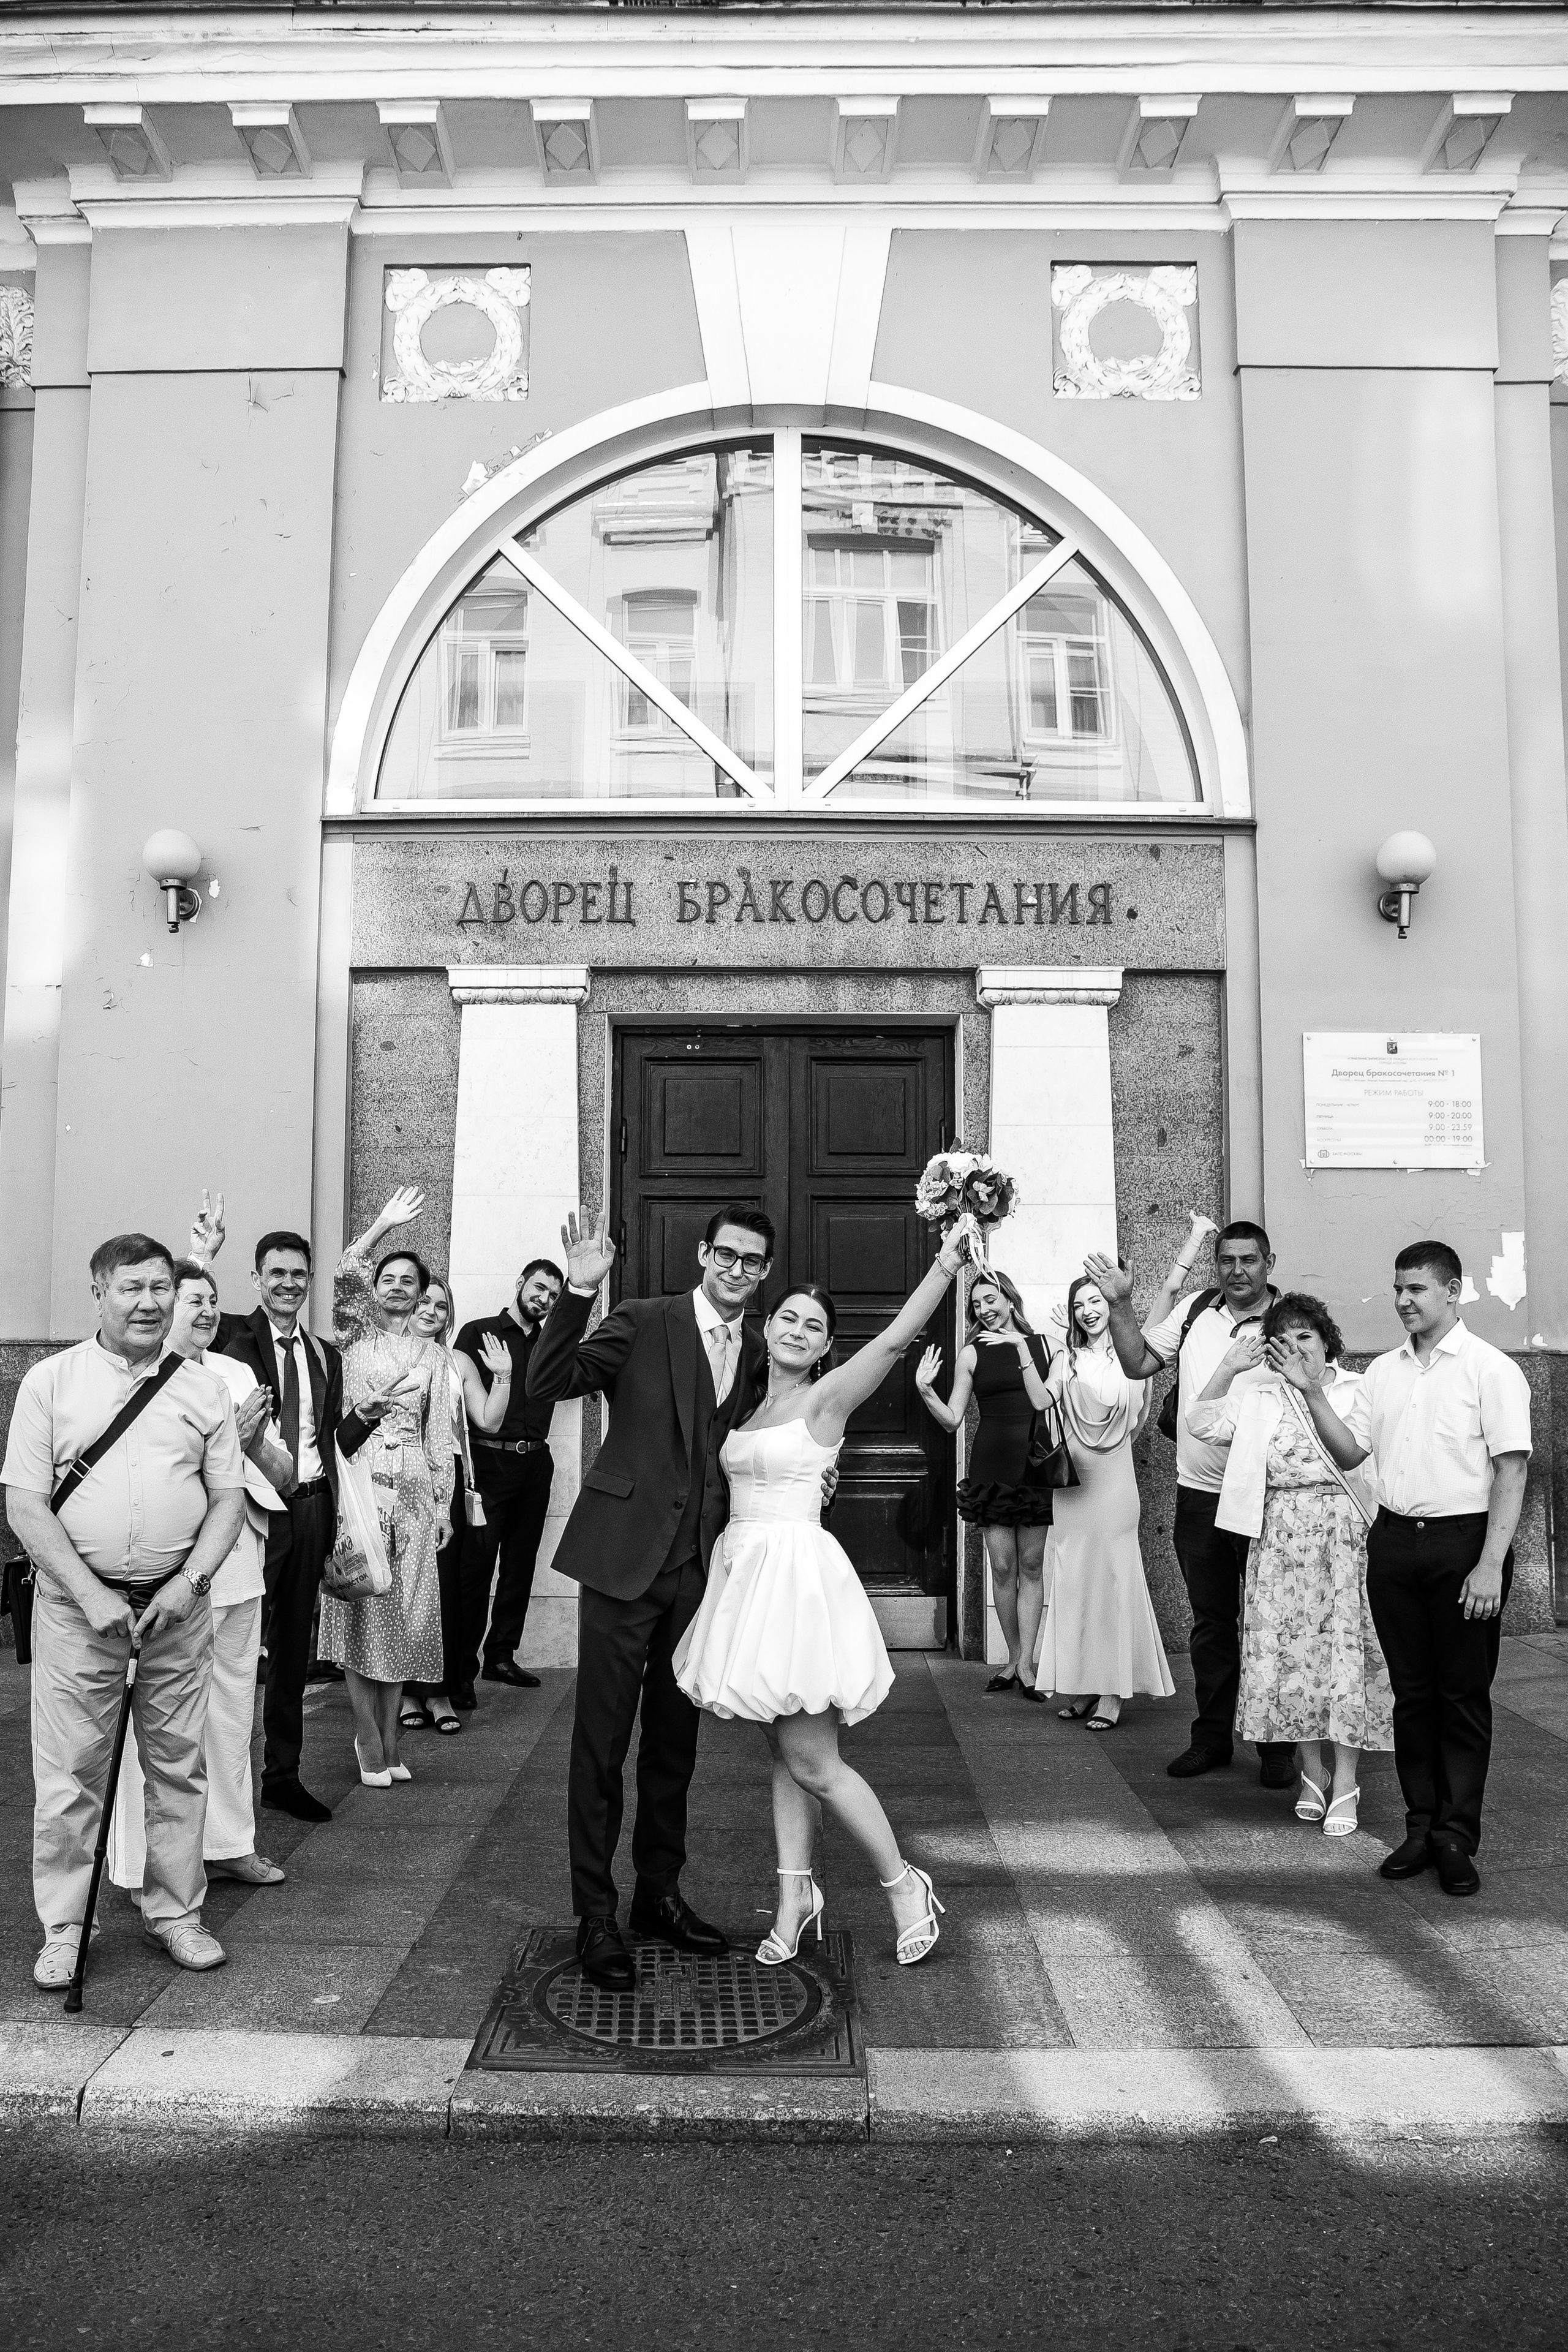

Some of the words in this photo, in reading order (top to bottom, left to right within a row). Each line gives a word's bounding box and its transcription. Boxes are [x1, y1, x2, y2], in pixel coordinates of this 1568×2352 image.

[456, 878, 636, 927] ДВОРЕЦ
[676, 878, 1113, 925] БРАКОСОЧЕТАНИЯ
[1332, 1069, 1364, 1077] Дворец
[1366, 1069, 1436, 1078] бракосочетания
